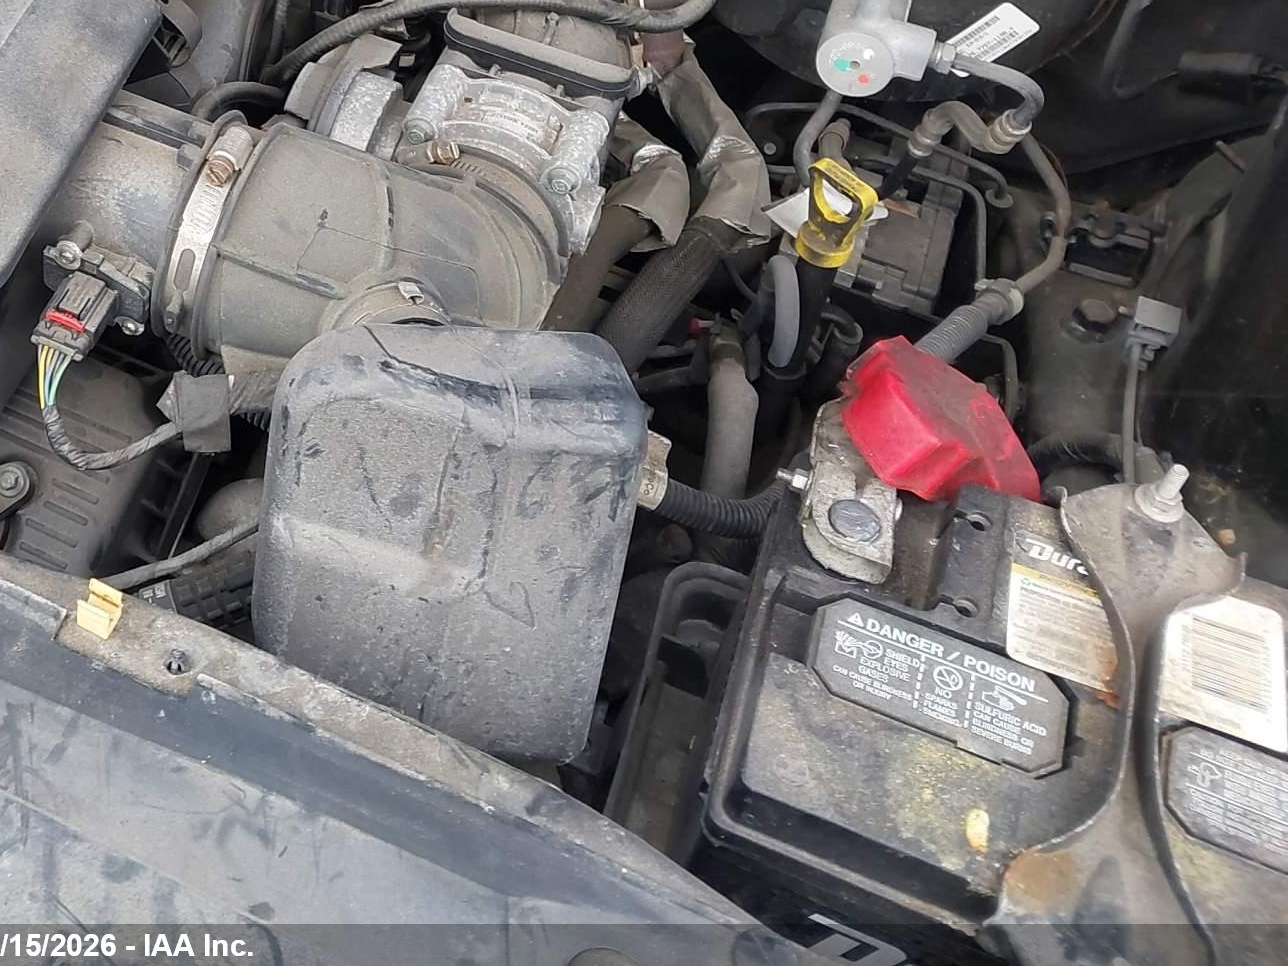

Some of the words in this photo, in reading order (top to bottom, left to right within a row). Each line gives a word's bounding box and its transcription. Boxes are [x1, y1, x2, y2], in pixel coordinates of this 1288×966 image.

[865, 617, 945, 658] DANGER
[962, 654, 1036, 693] POISON
[883, 656, 909, 673] EYES
[884, 647, 920, 668] SHIELD
[857, 664, 889, 683] GASES
[859, 655, 911, 682] EXPLOSIVE
[934, 686, 953, 700] NO
[973, 700, 1022, 727] SULFURIC
[1022, 720, 1047, 737] ACID
